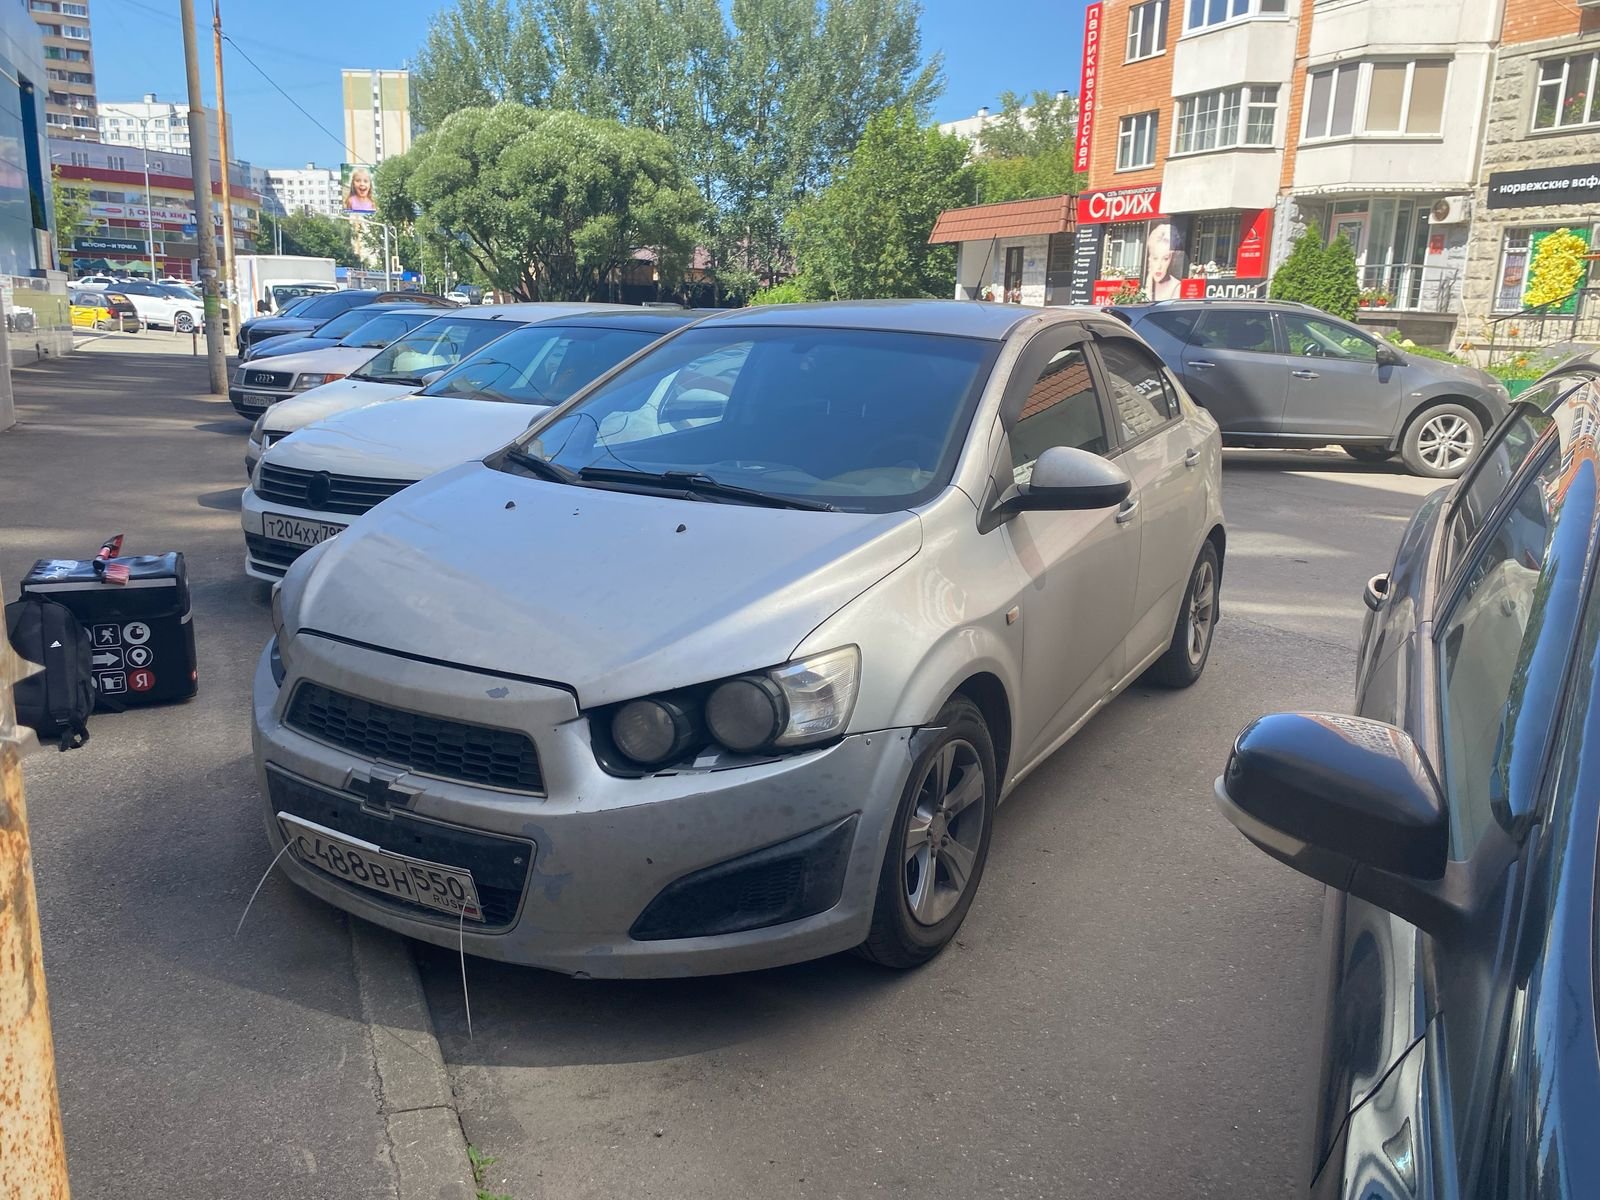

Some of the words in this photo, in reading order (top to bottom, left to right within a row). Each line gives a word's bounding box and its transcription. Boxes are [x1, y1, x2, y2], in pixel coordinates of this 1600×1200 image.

[1500, 179, 1569, 194] норвежские
[1088, 192, 1156, 220] Стриж
[1206, 284, 1258, 299] САЛОН
[136, 672, 148, 688] Я
[432, 894, 459, 909] RUS
